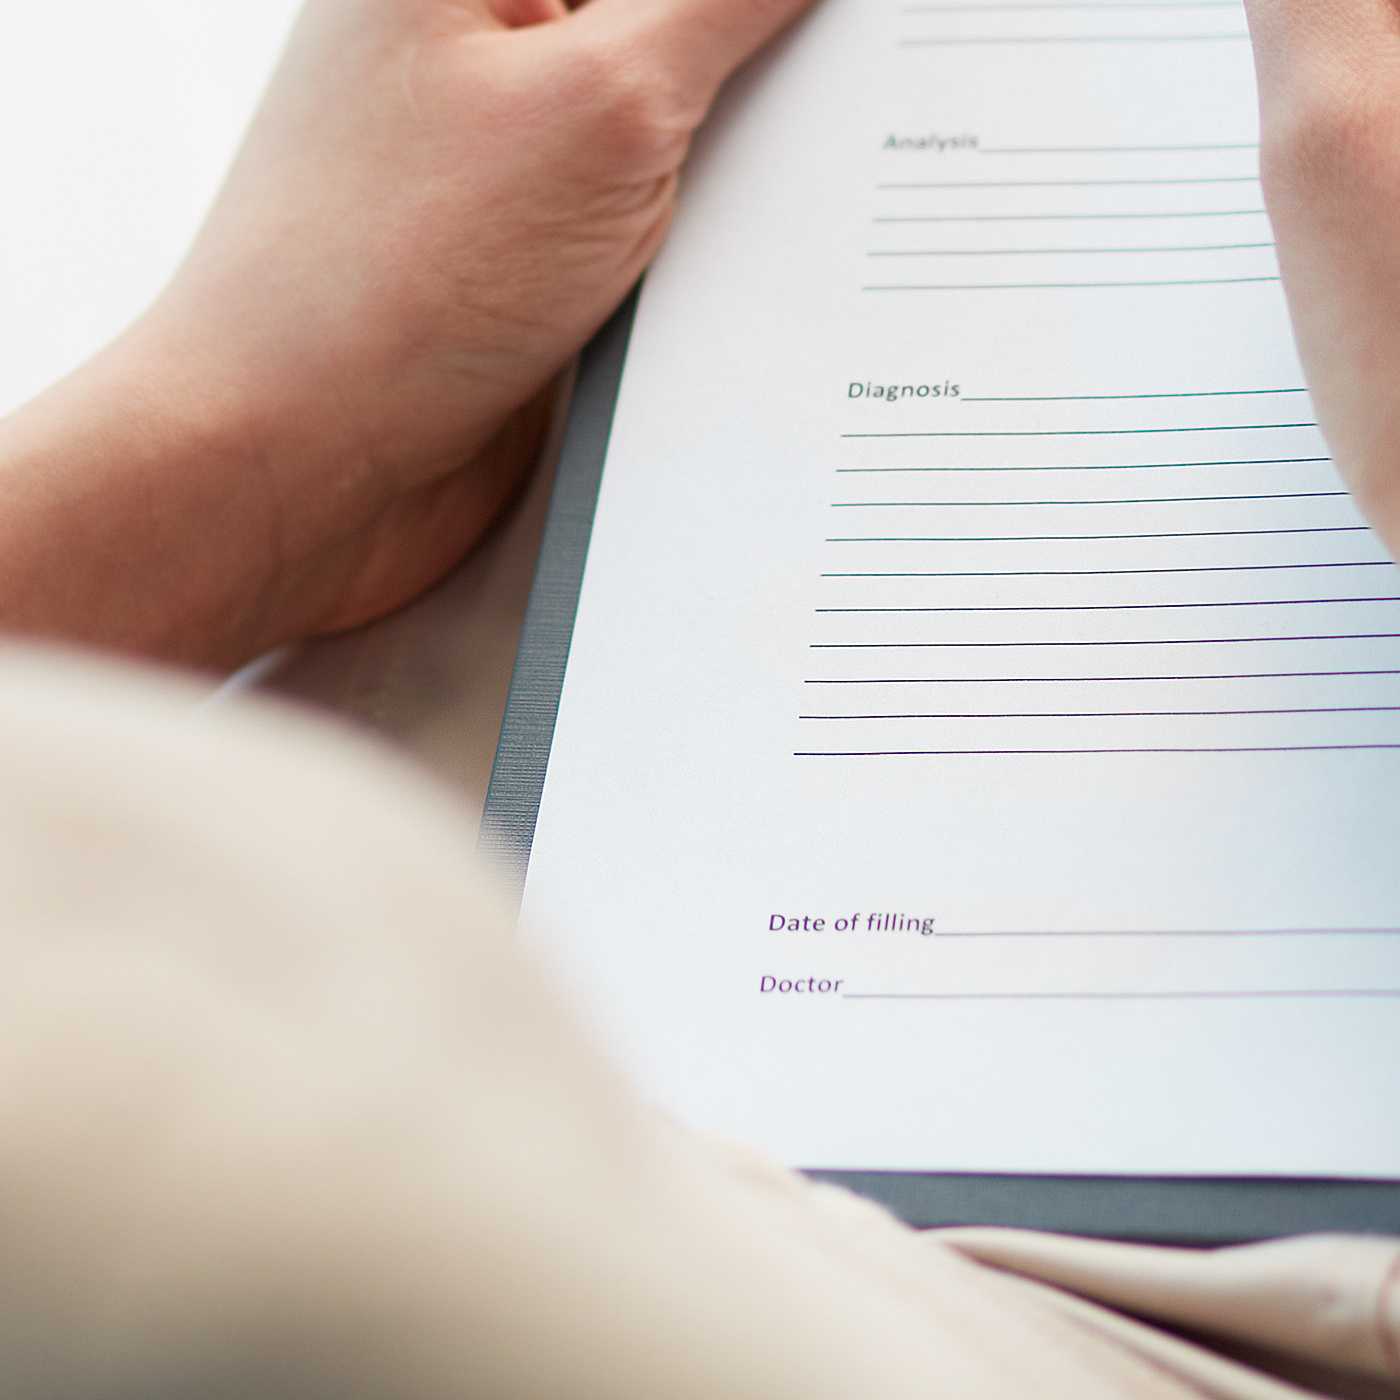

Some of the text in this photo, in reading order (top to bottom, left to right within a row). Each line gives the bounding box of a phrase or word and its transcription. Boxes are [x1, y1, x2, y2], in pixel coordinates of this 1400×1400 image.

[882, 133, 979, 152] Analysis
[848, 380, 959, 402] Diagnosis
[769, 913, 935, 936] Date of filling
[760, 975, 844, 993] Doctor
